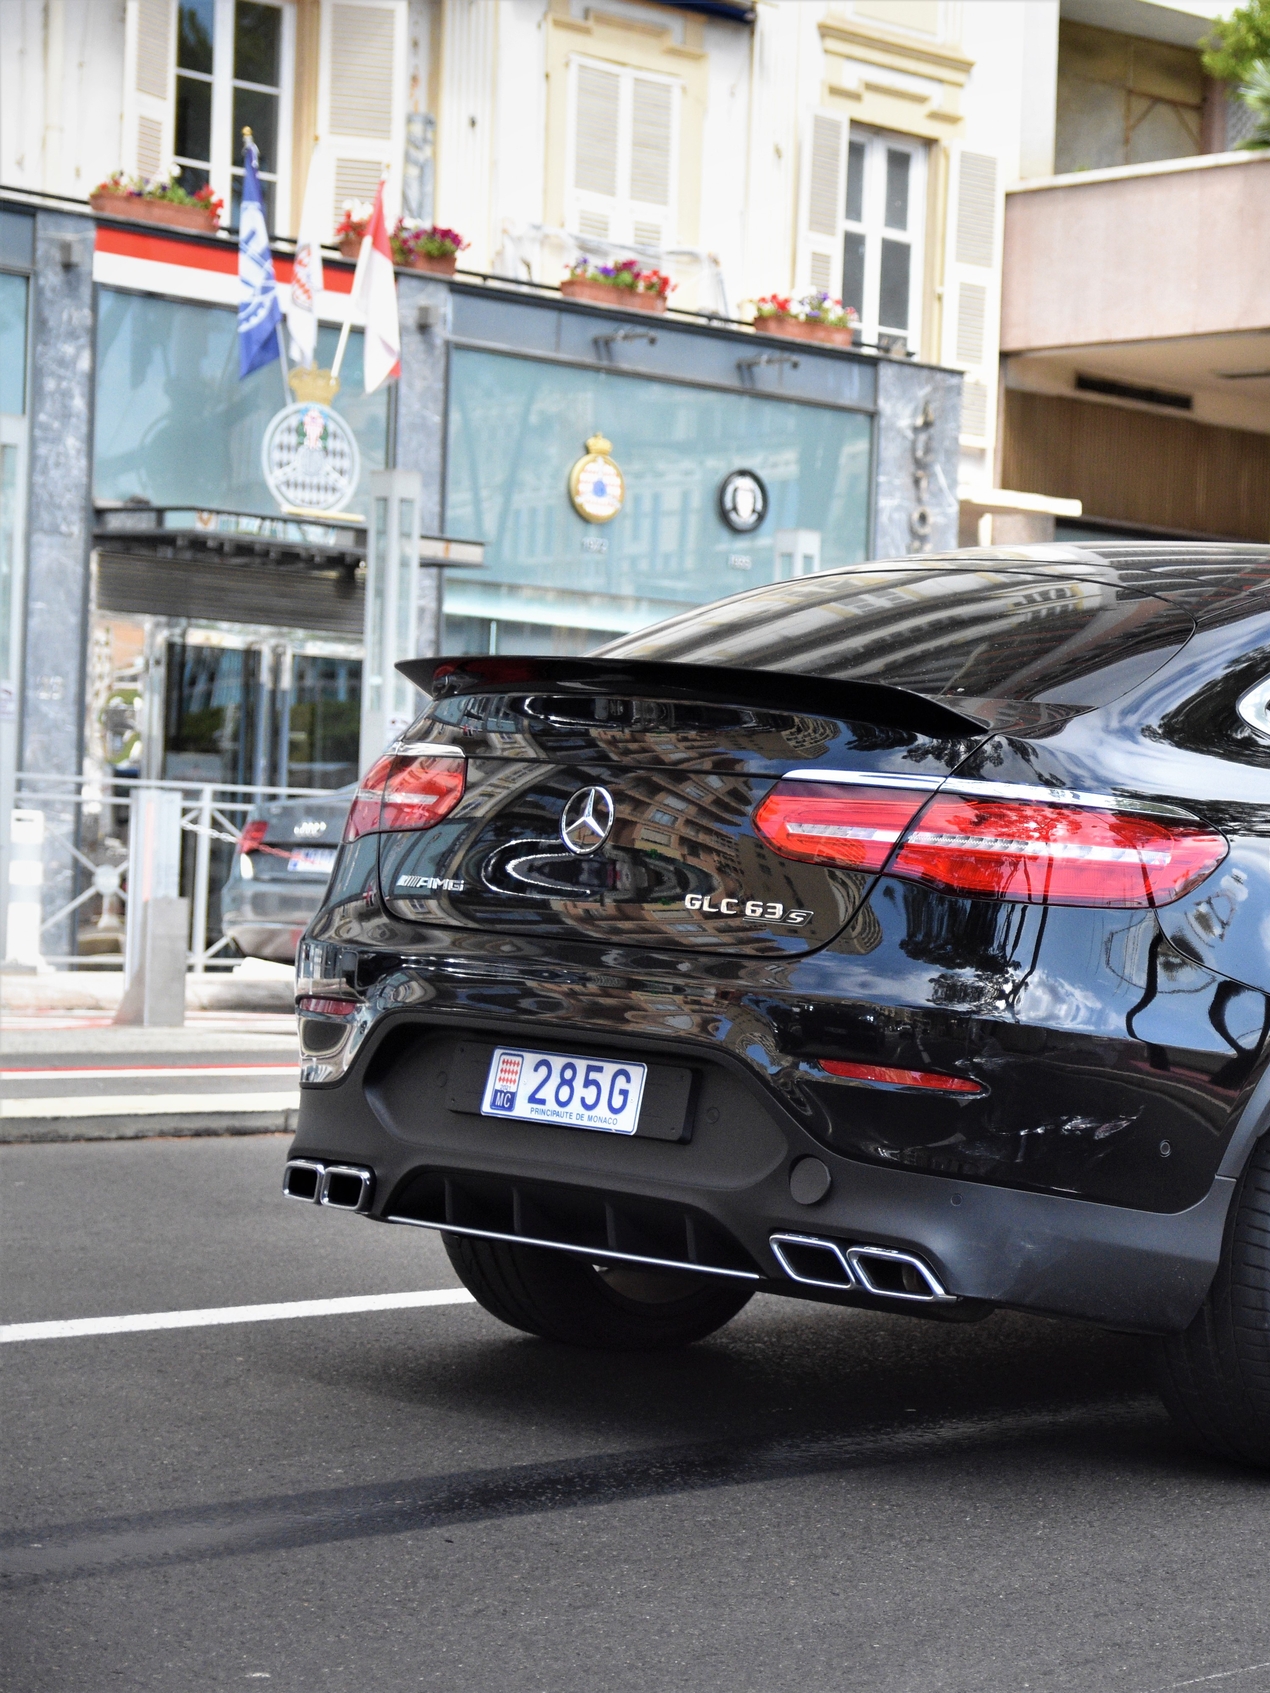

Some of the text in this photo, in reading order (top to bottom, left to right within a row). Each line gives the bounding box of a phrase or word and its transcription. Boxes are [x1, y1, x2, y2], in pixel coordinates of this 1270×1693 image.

[416, 876, 464, 891] AMG
[684, 893, 807, 923] GLC 63 S
[527, 1058, 632, 1115] 285G
[495, 1090, 512, 1108] MC
[530, 1107, 618, 1126] PRINCIPAUTE DE MONACO
